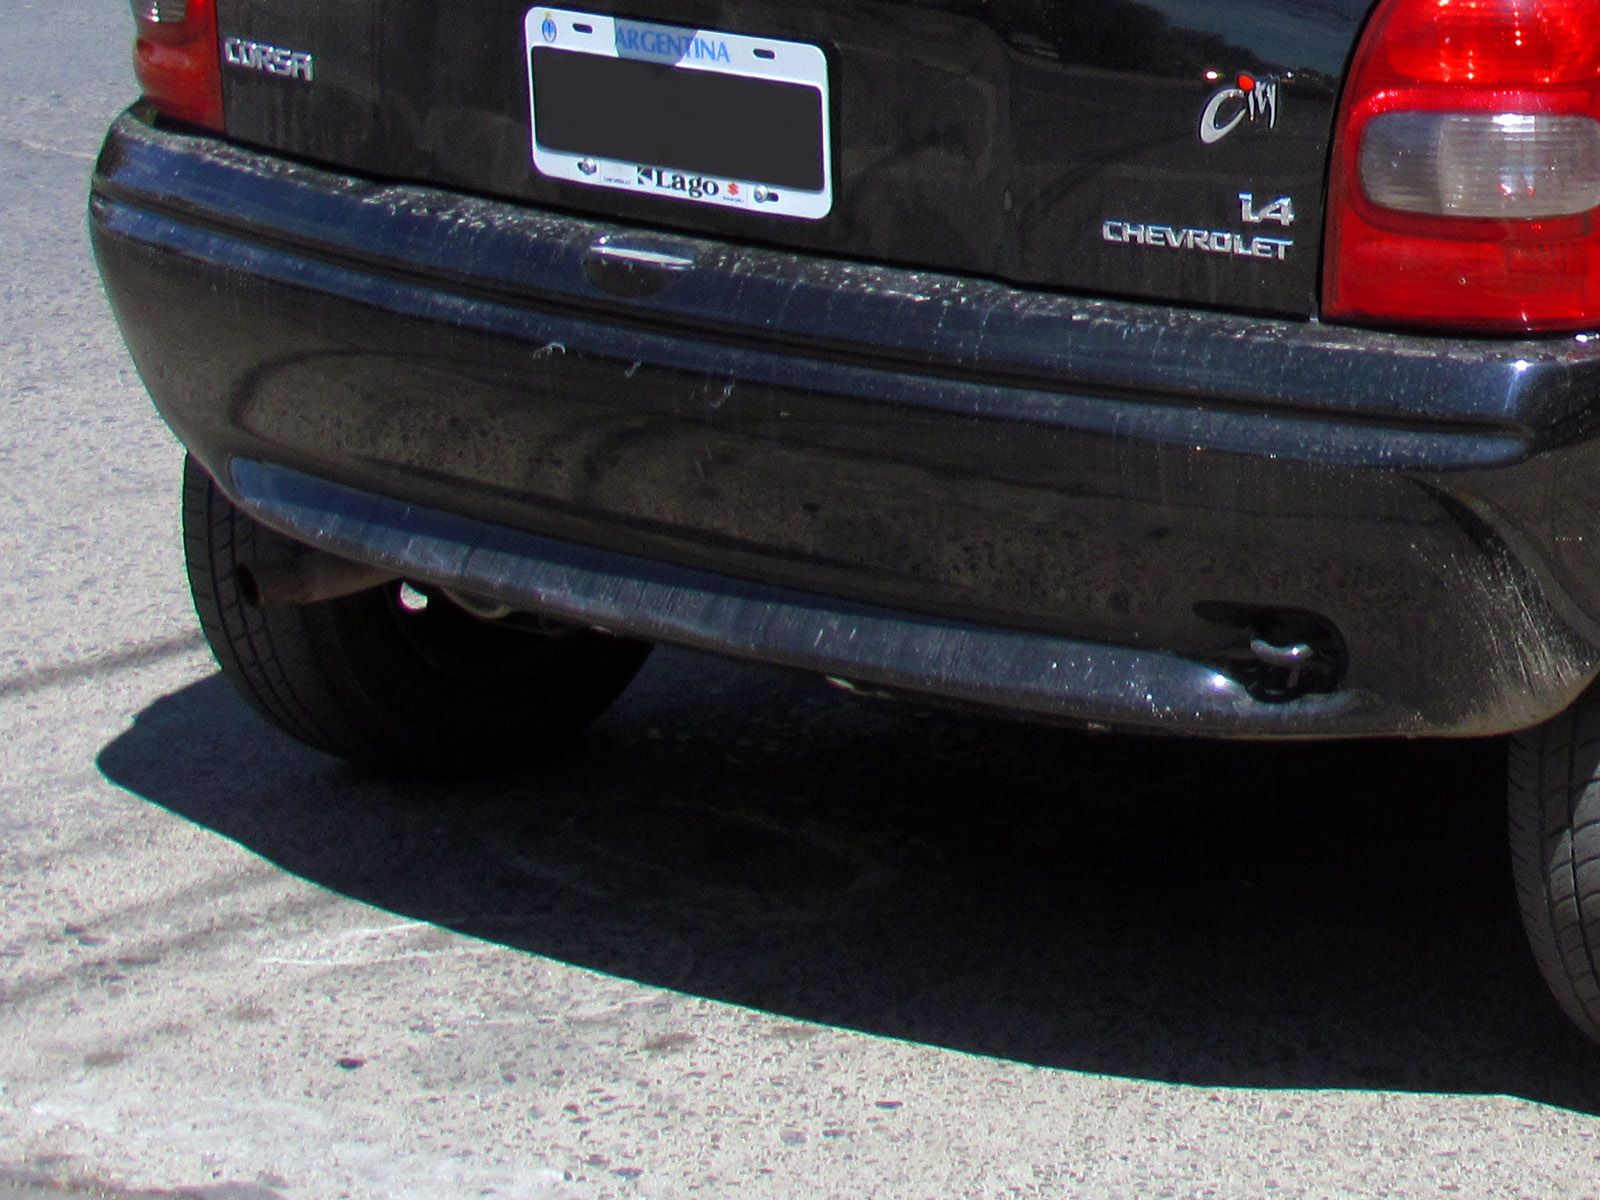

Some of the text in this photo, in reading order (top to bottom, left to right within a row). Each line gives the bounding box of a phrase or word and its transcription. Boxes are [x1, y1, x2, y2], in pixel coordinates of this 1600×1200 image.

[224, 37, 314, 81] CORSA
[615, 26, 731, 64] ARGENTINA
[655, 168, 720, 199] Lago
[1102, 218, 1294, 261] CHEVROLET
